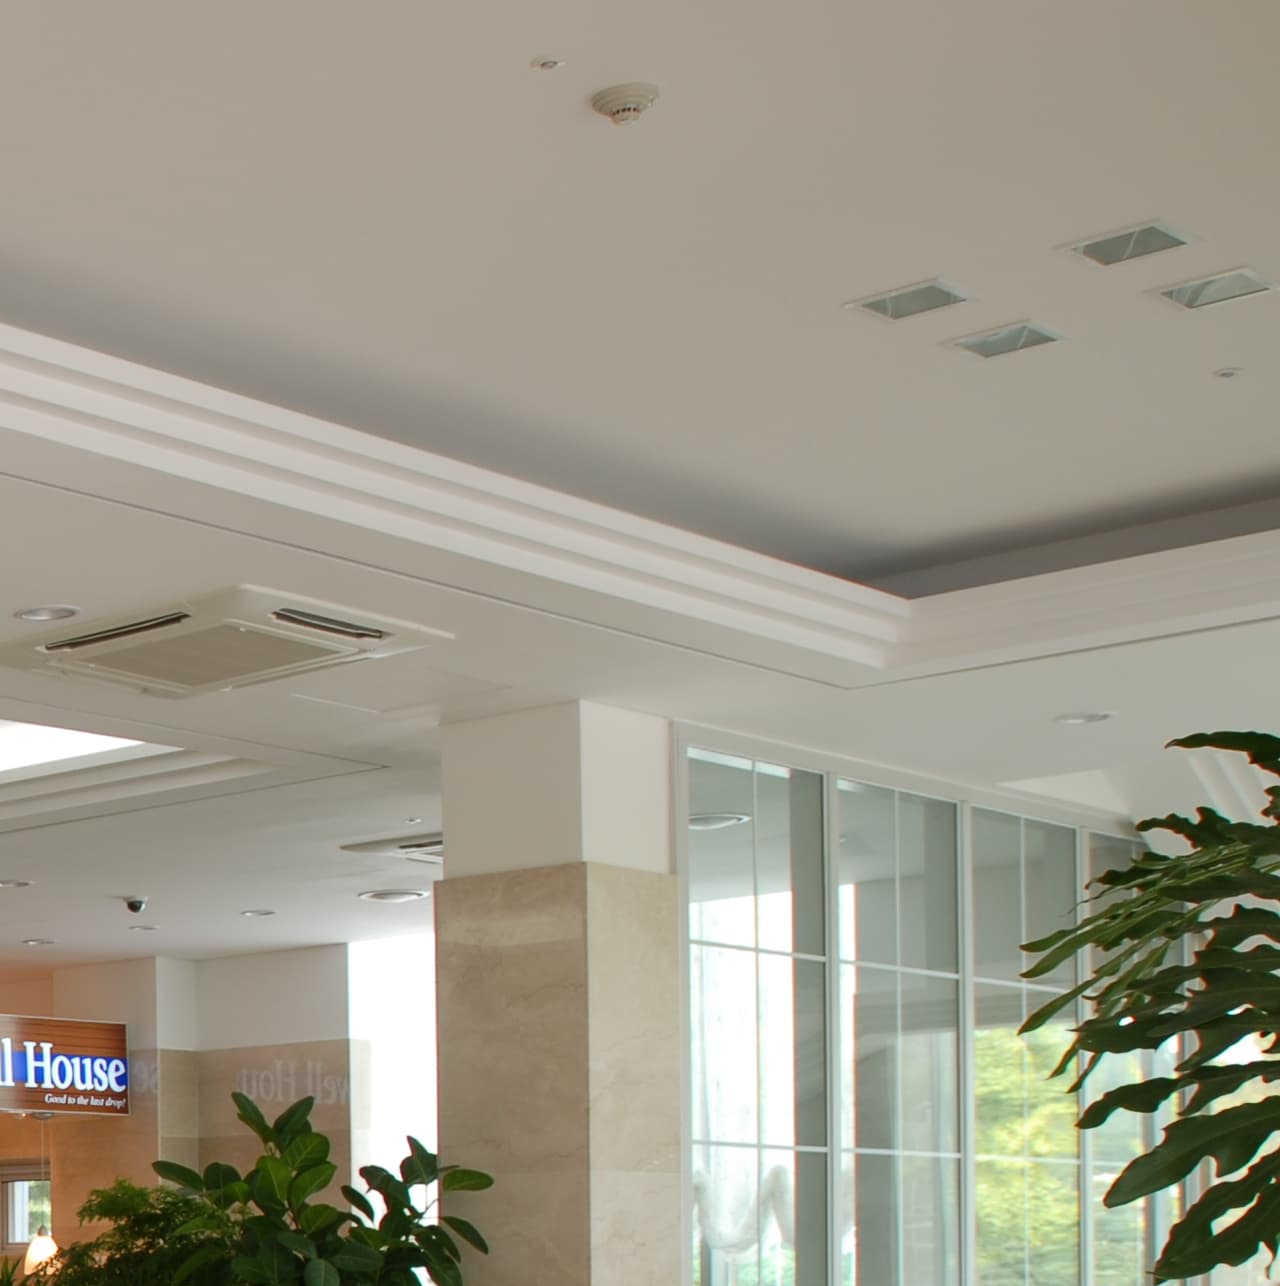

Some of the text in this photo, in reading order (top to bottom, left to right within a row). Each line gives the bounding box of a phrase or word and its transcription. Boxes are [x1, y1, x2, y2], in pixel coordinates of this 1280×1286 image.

[23, 1041, 127, 1093] House
[44, 1093, 67, 1104] Good
[68, 1095, 76, 1104] to
[77, 1095, 89, 1105] the
[90, 1096, 104, 1106] last
